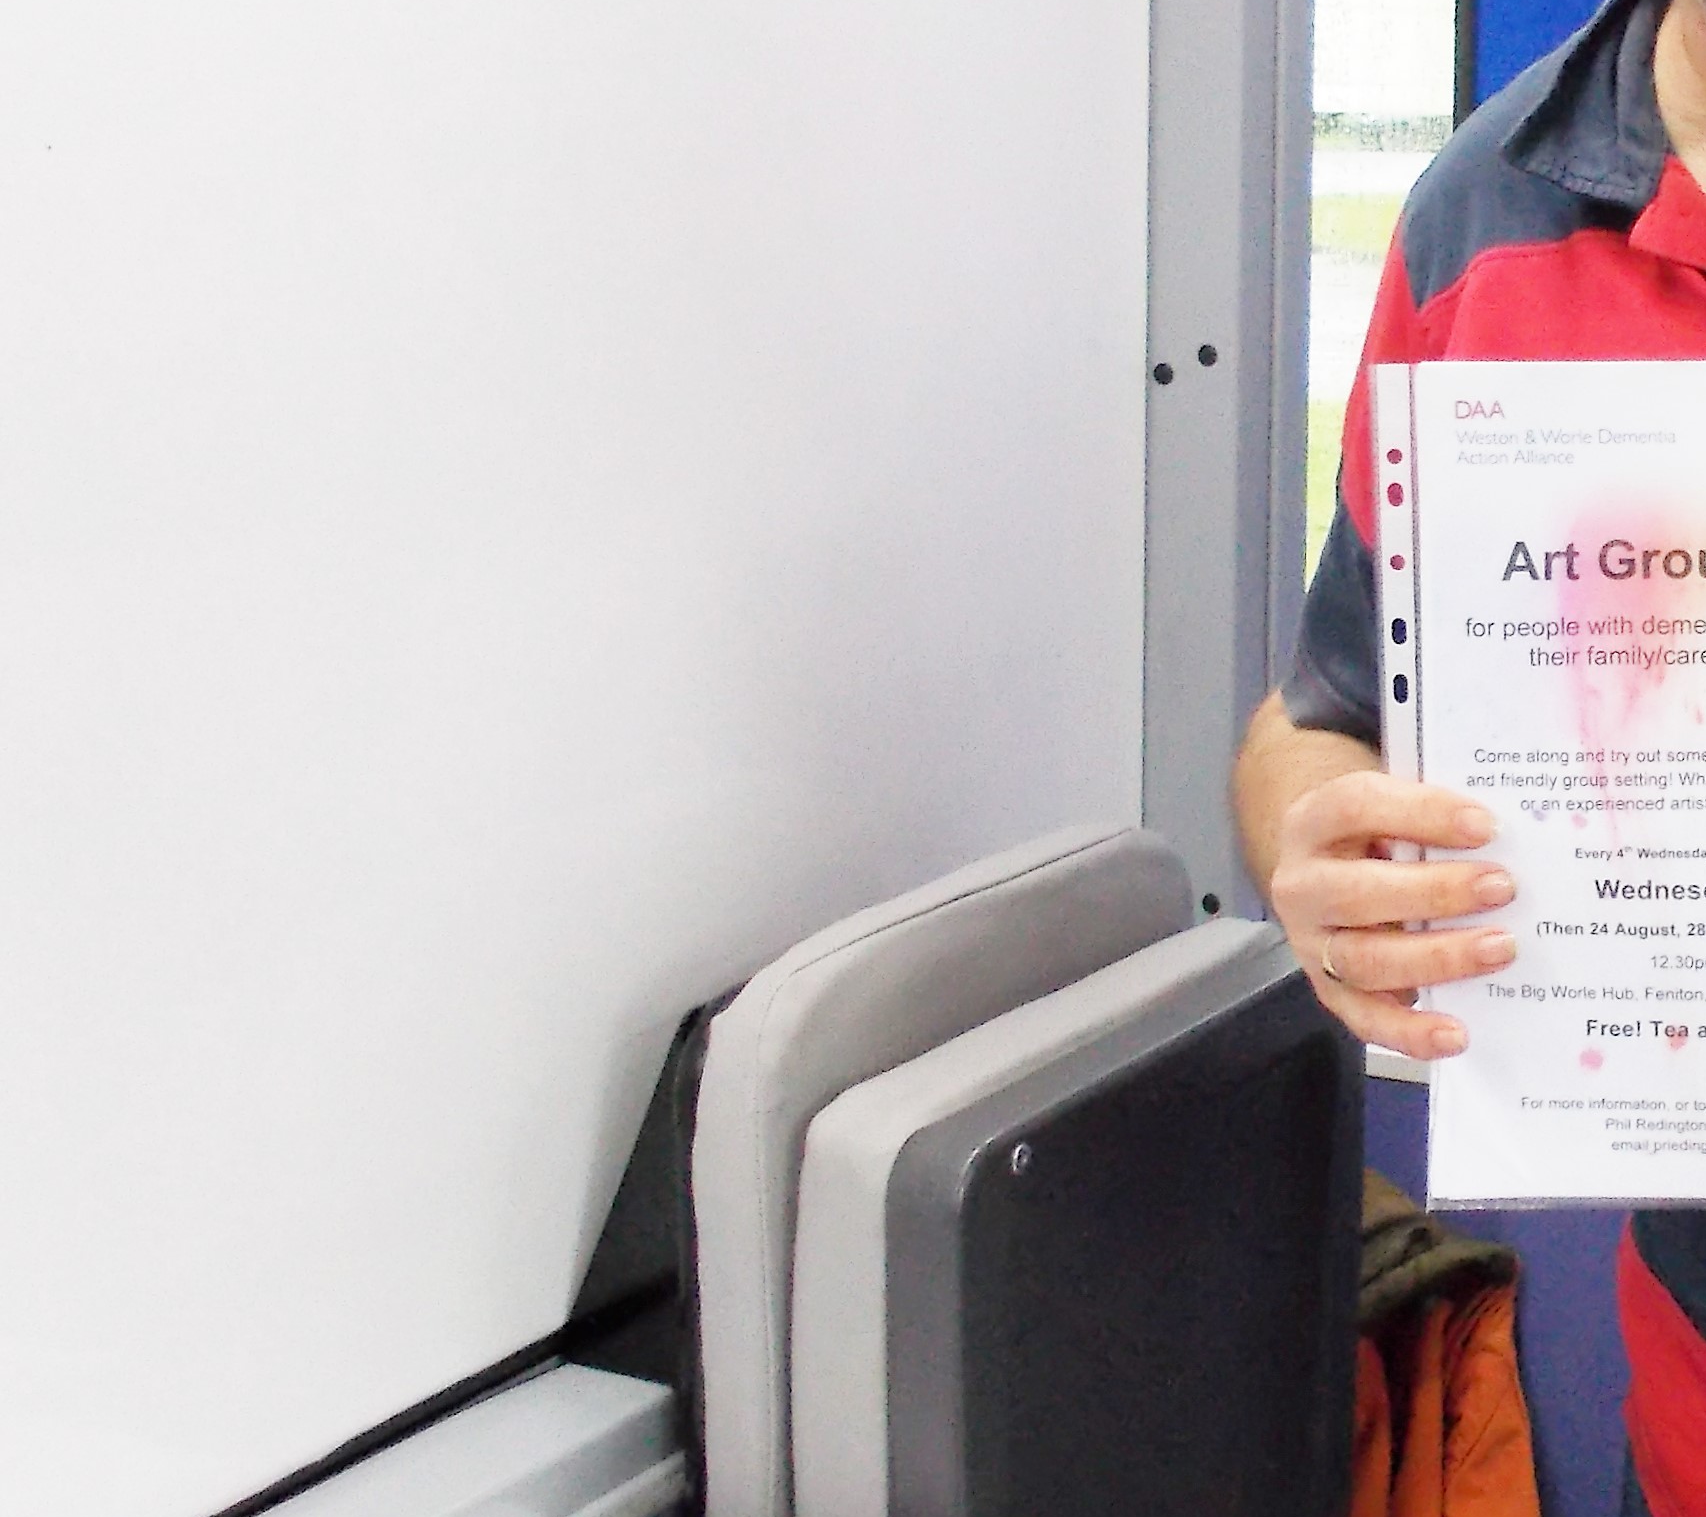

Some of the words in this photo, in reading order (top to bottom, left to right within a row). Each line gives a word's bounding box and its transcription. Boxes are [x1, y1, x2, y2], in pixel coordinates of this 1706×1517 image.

[1454, 399, 1506, 420] DAA
[1455, 449, 1510, 466] Action
[1512, 448, 1576, 466] Alliance
[1501, 540, 1581, 582] Art
[1465, 616, 1496, 638] for
[1502, 615, 1582, 642] people
[1586, 615, 1636, 637] with
[1529, 646, 1582, 667] their
[1473, 747, 1522, 764] Come
[1525, 749, 1570, 767] along
[1575, 747, 1606, 764] and
[1610, 749, 1631, 767] try
[1635, 748, 1662, 764] out
[1466, 774, 1496, 788] and
[1499, 772, 1558, 792] friendly
[1562, 769, 1610, 792] group
[1613, 772, 1673, 791] setting!
[1518, 798, 1537, 812] or
[1539, 798, 1562, 812] an
[1565, 796, 1667, 814] experienced
[1574, 847, 1614, 862] Every
[1536, 920, 1584, 936] (Then
[1589, 921, 1609, 936] 24
[1614, 922, 1681, 941] August,
[1686, 922, 1706, 937] 28
[1486, 984, 1516, 999] The
[1520, 984, 1547, 1003] Big
[1550, 984, 1597, 1000] Worle
[1586, 1018, 1642, 1038] Free!
[1649, 1020, 1690, 1039] Tea
[1520, 1096, 1544, 1110] For
[1548, 1099, 1585, 1111] more
[1674, 1100, 1690, 1112] or
[1604, 1117, 1632, 1131] Phil
